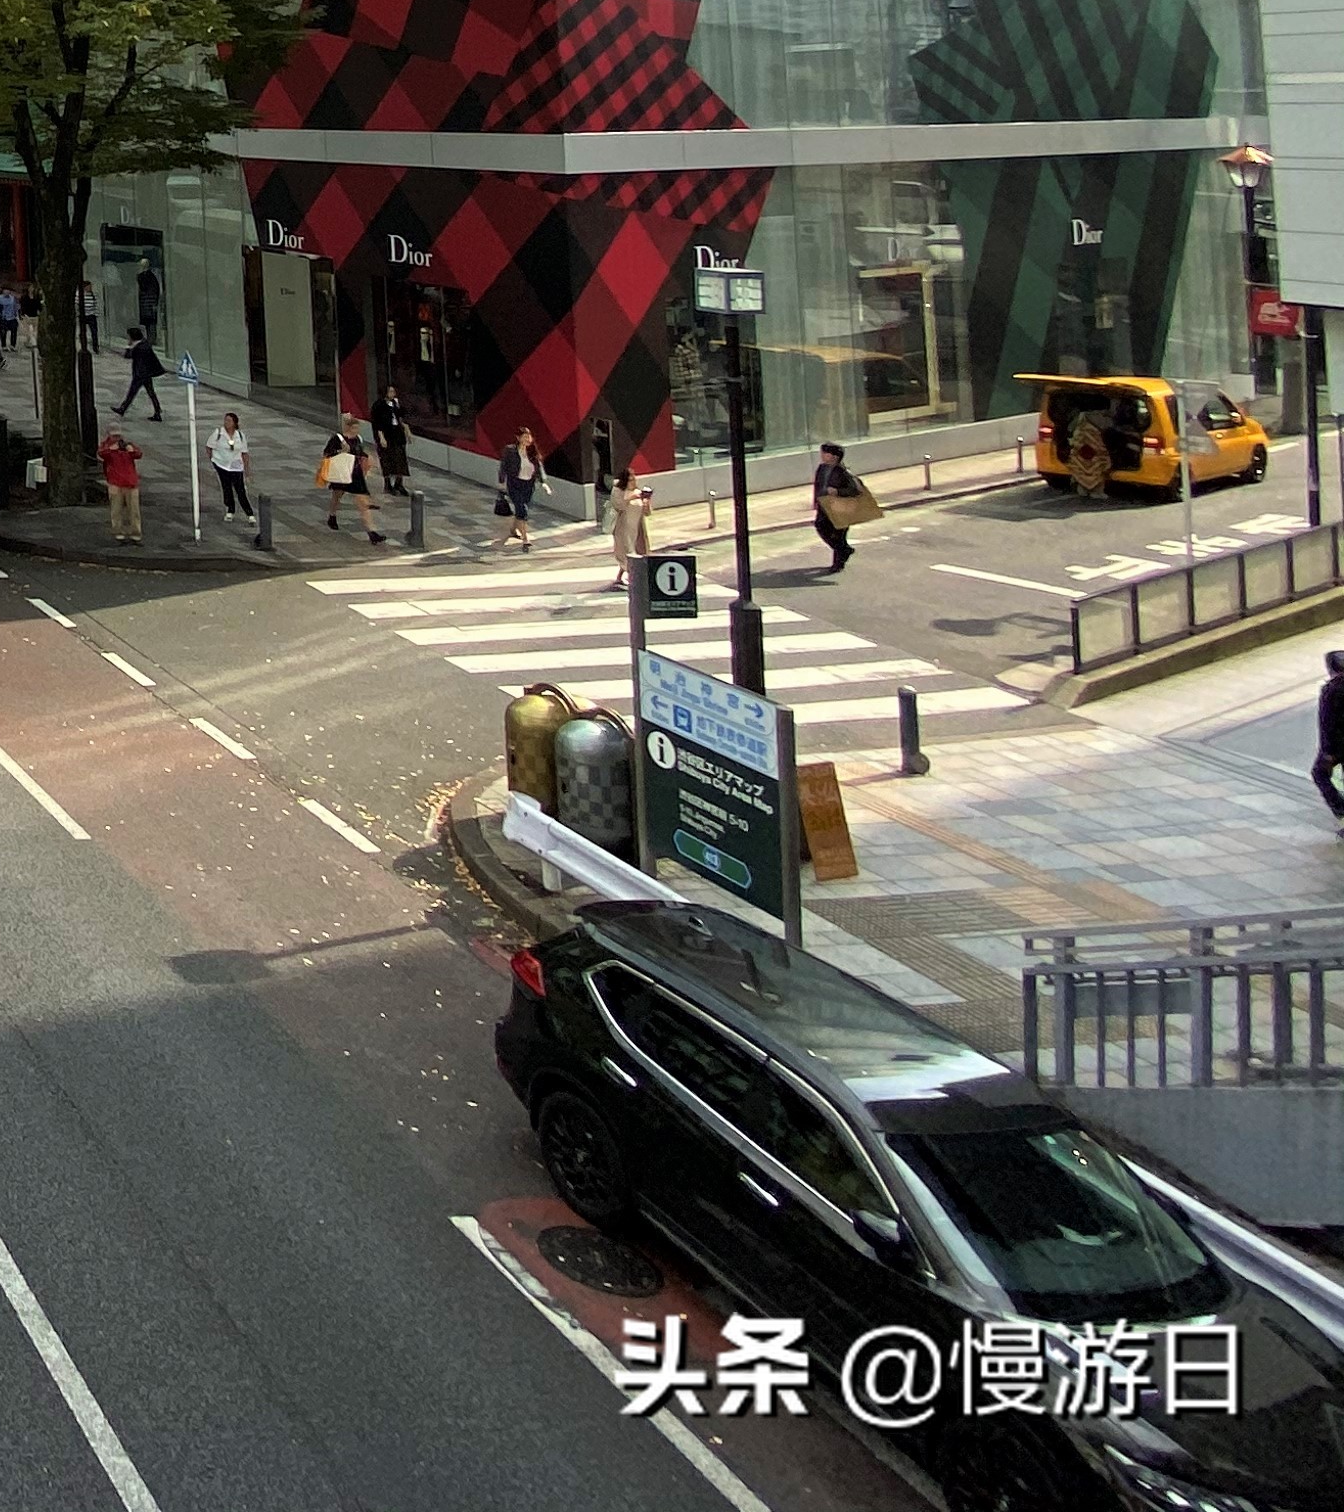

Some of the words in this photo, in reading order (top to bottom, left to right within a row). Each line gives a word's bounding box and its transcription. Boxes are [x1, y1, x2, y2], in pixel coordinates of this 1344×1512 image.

[267, 219, 304, 249] Dior
[1072, 219, 1104, 246] Dior
[388, 234, 433, 268] Dior
[694, 245, 740, 268] Dior
